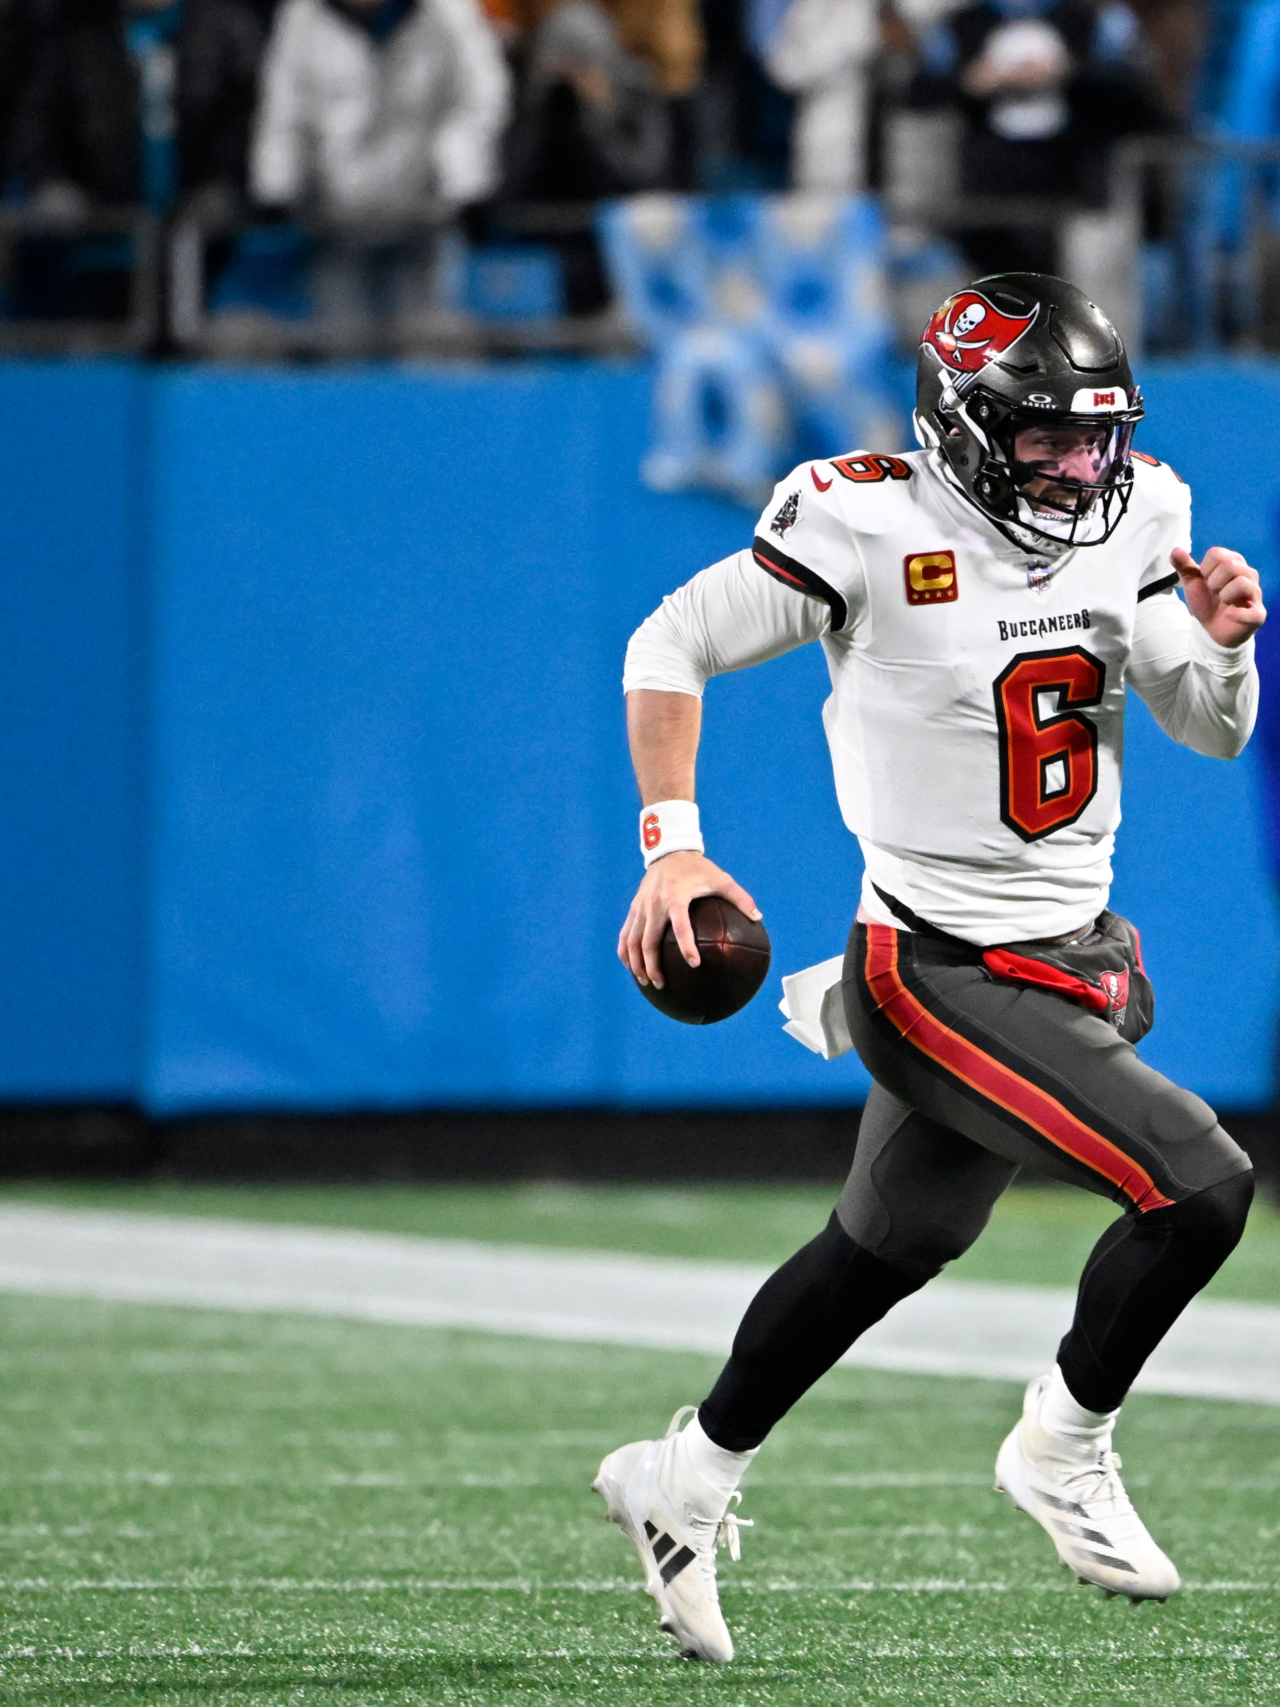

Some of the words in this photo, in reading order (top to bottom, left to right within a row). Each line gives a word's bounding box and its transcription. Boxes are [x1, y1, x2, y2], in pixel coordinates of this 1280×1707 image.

[1022, 400, 1057, 410] OAKLEY
[829, 453, 914, 484] 6
[909, 554, 954, 591] C
[997, 609, 1091, 641] BUCCANEERS
[992, 645, 1107, 844] 6
[642, 813, 662, 851] 6
